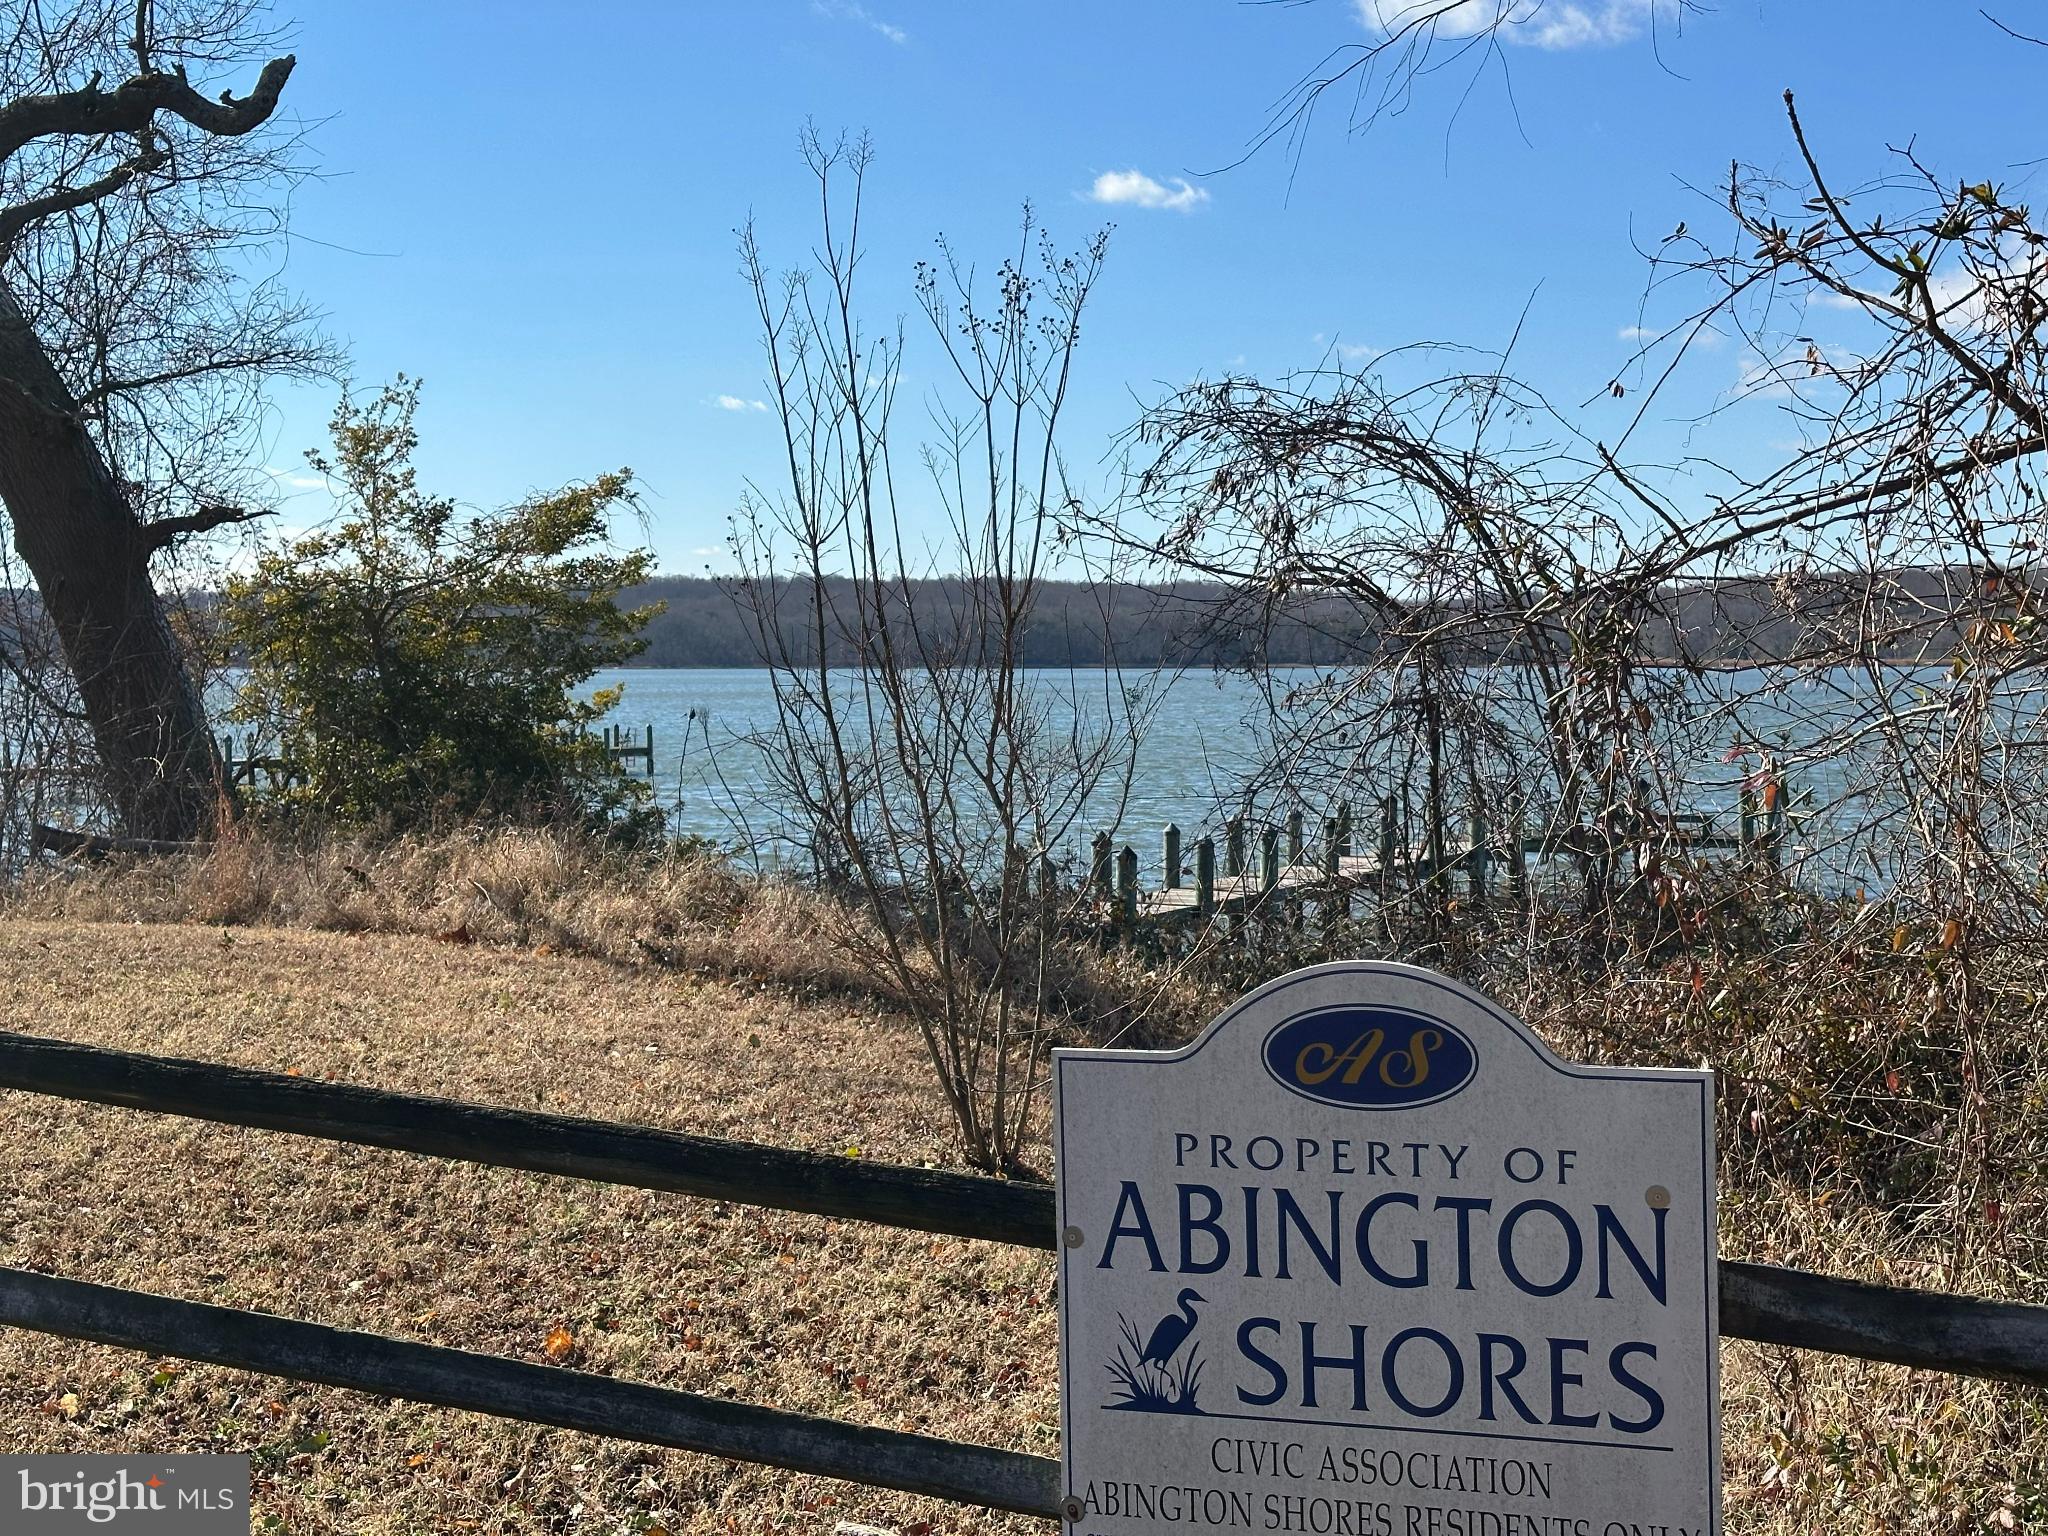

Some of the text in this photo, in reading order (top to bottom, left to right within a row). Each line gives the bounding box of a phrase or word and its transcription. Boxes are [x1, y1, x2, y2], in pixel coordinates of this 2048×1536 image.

[1296, 1028, 1444, 1088] AS
[1174, 1132, 1577, 1185] PROPERTY OF
[1097, 1180, 1670, 1306] ABINGTON
[1235, 1317, 1666, 1434] SHORES
[1211, 1437, 1553, 1499] CIVIC ASSOCIATION
[1083, 1480, 1253, 1528] ABINGTON
[1264, 1494, 1392, 1536] SHORES
